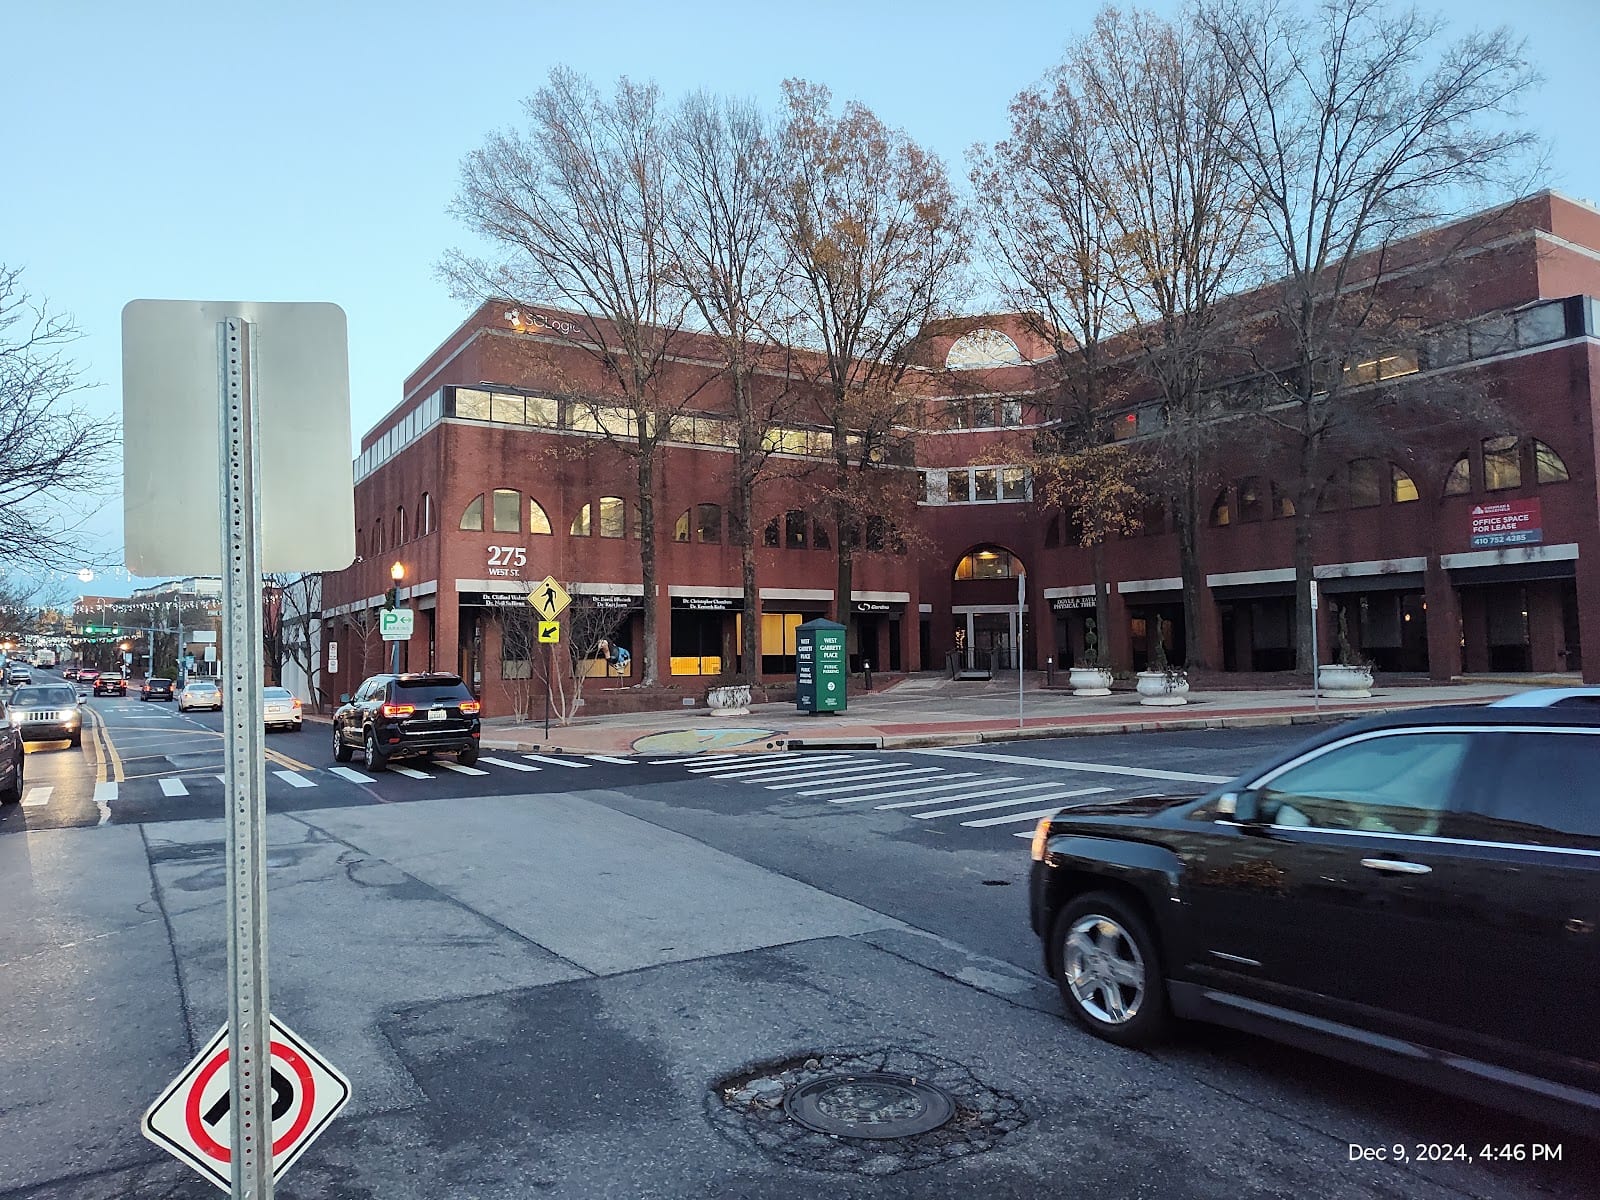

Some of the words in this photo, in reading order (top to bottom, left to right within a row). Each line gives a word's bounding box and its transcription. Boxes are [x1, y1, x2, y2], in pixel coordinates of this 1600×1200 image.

[1472, 518, 1501, 526] OFFICE
[1503, 514, 1529, 523] SPACE
[1491, 522, 1516, 531] LEASE
[488, 546, 526, 566] 275
[488, 568, 509, 576] WEST
